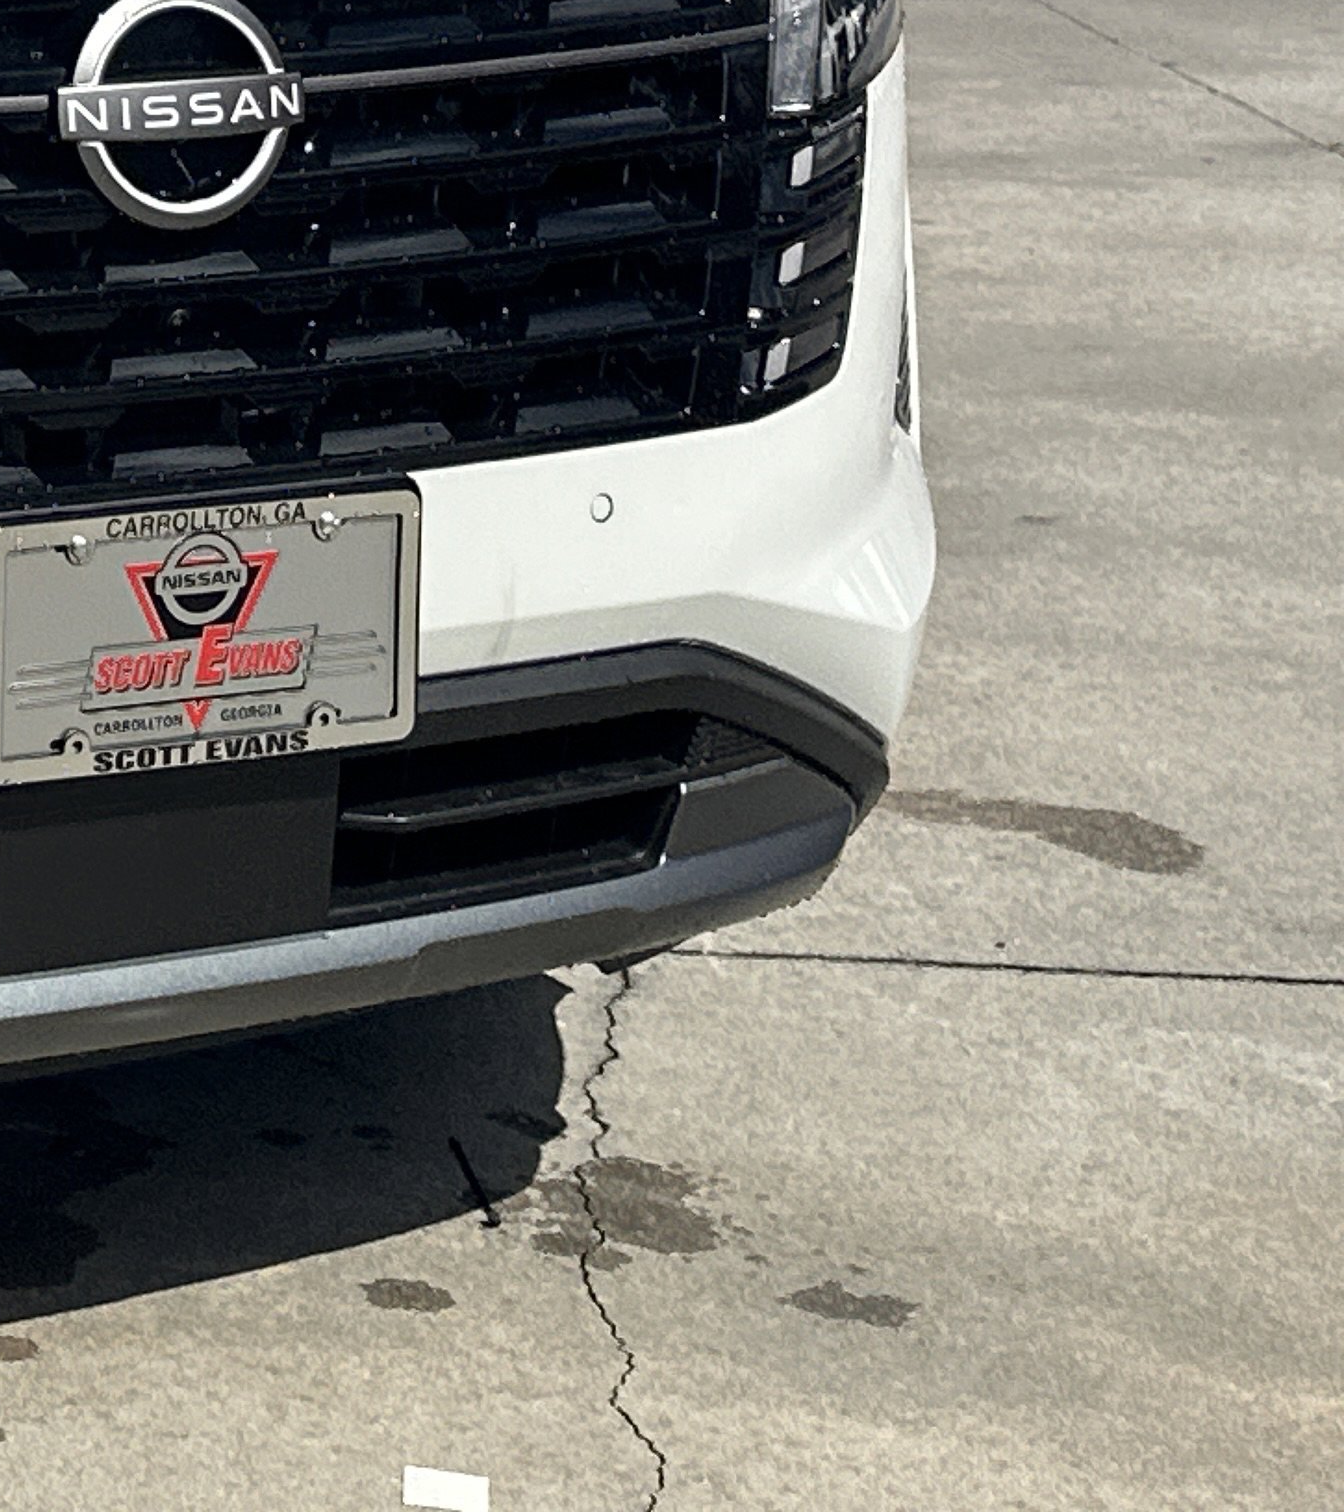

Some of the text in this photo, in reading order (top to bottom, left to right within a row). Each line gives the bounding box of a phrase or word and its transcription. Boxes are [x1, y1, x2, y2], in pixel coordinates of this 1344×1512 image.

[66, 83, 300, 132] NISSAN
[275, 502, 307, 524] GA
[162, 569, 242, 590] NISSAN
[94, 648, 191, 694] SCOTT
[94, 704, 283, 737] CARROLLTON GEORGIA
[94, 729, 309, 773] SCOTT EVANS
